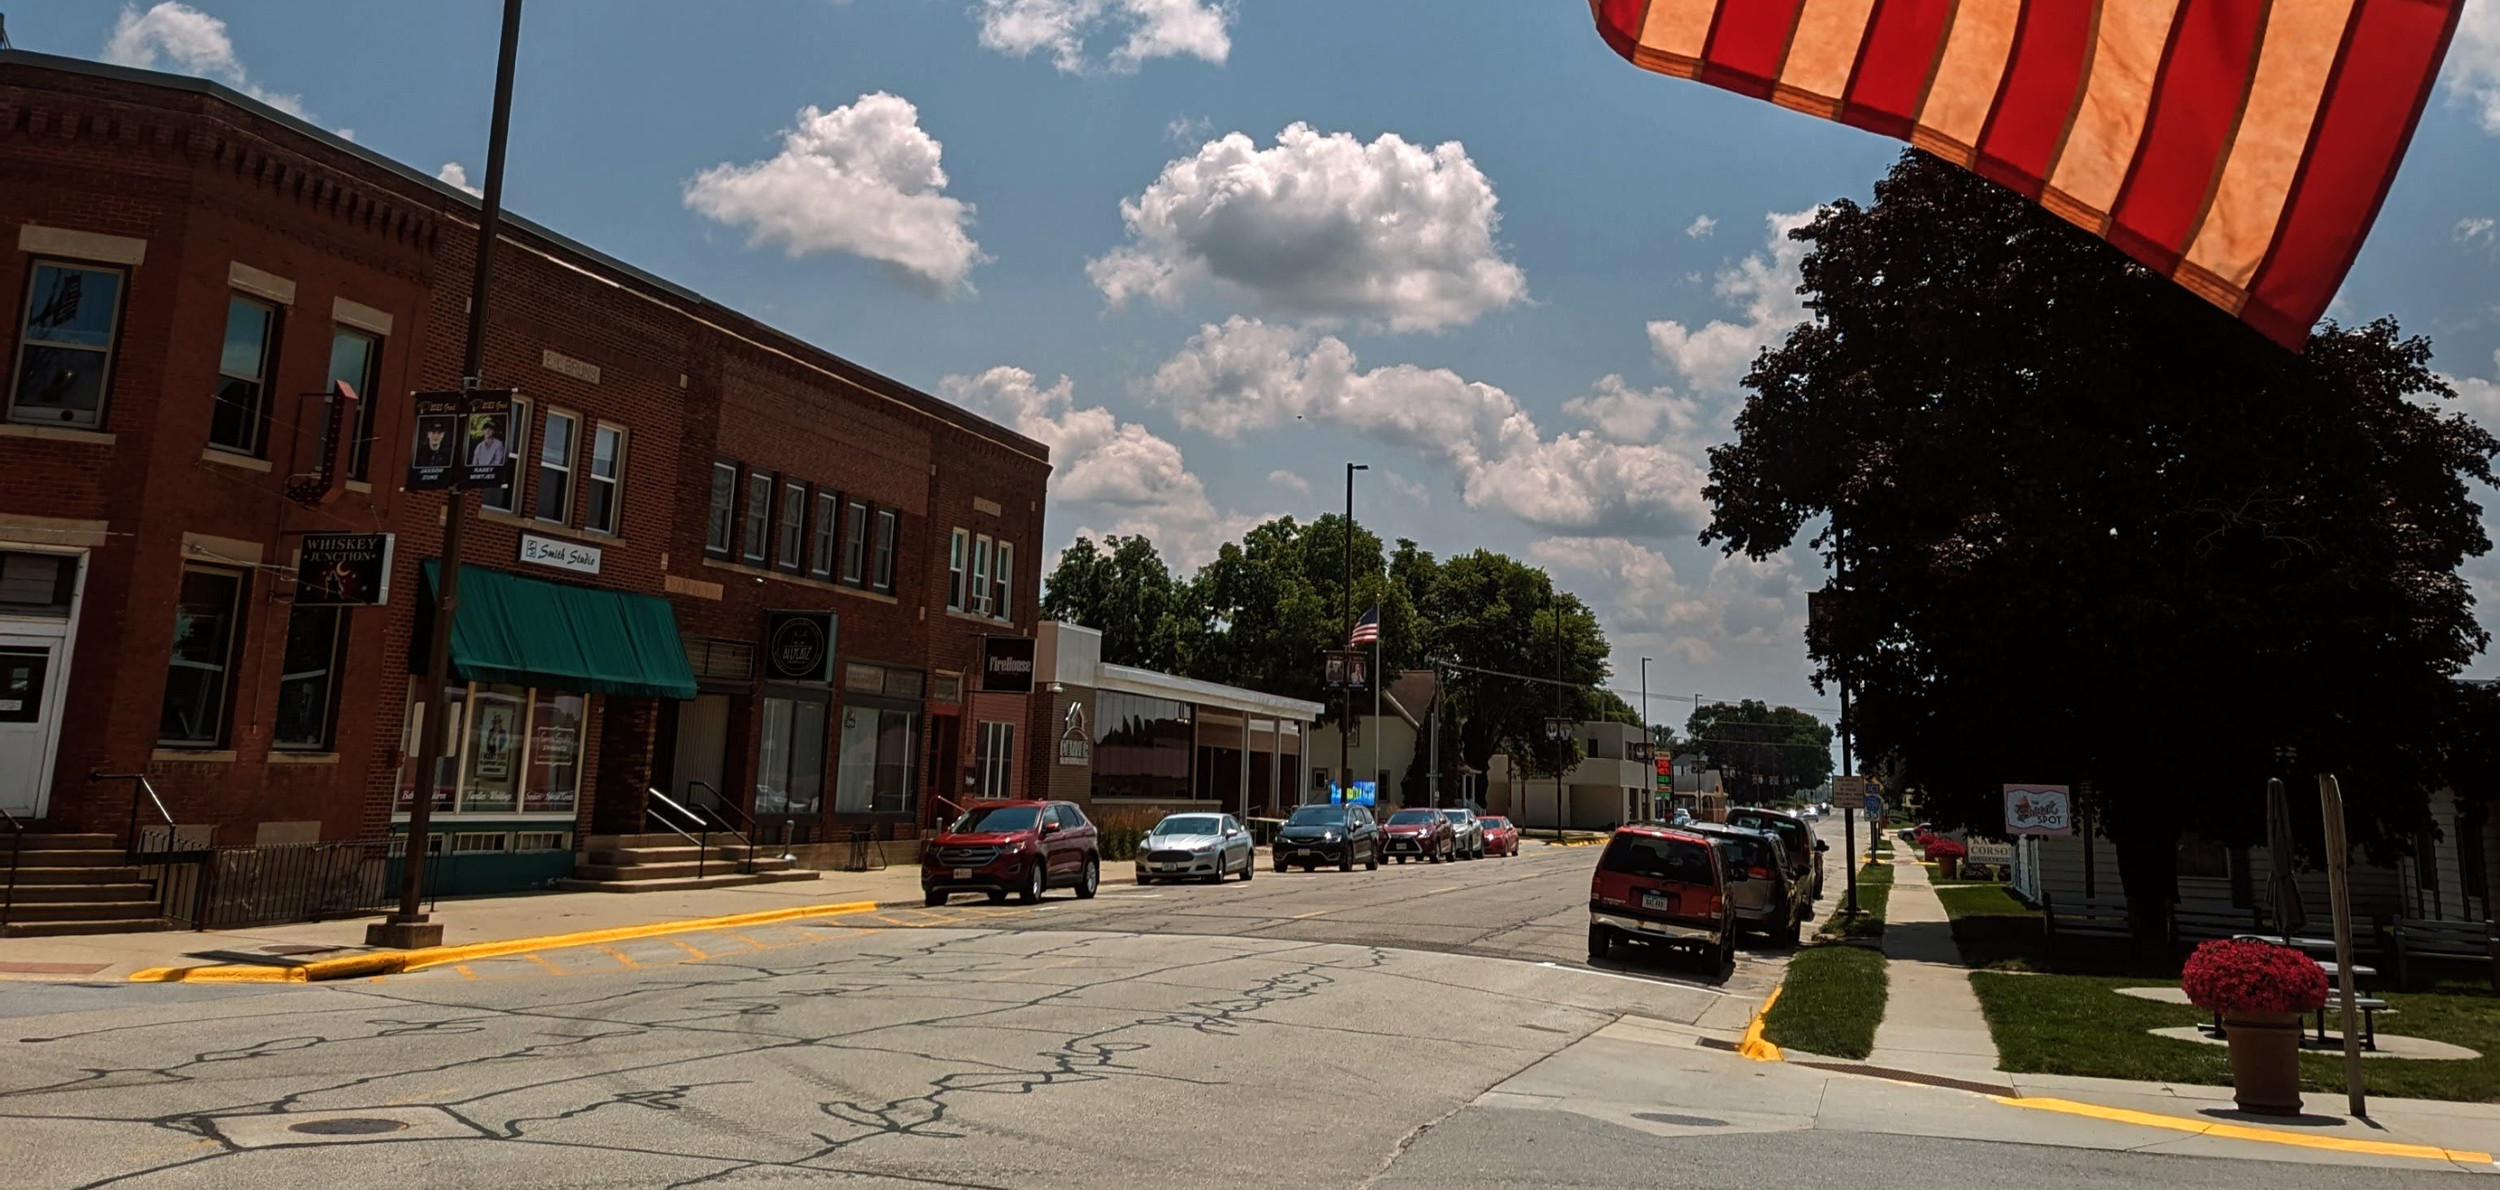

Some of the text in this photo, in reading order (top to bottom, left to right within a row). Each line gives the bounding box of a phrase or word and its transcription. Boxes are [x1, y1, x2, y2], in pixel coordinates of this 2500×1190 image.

[307, 538, 376, 550] WHISKEY
[310, 551, 370, 561] JUNCTION
[537, 543, 595, 566] Smith Studio
[989, 655, 1031, 673] FireHouse
[2038, 816, 2062, 825] SPOT
